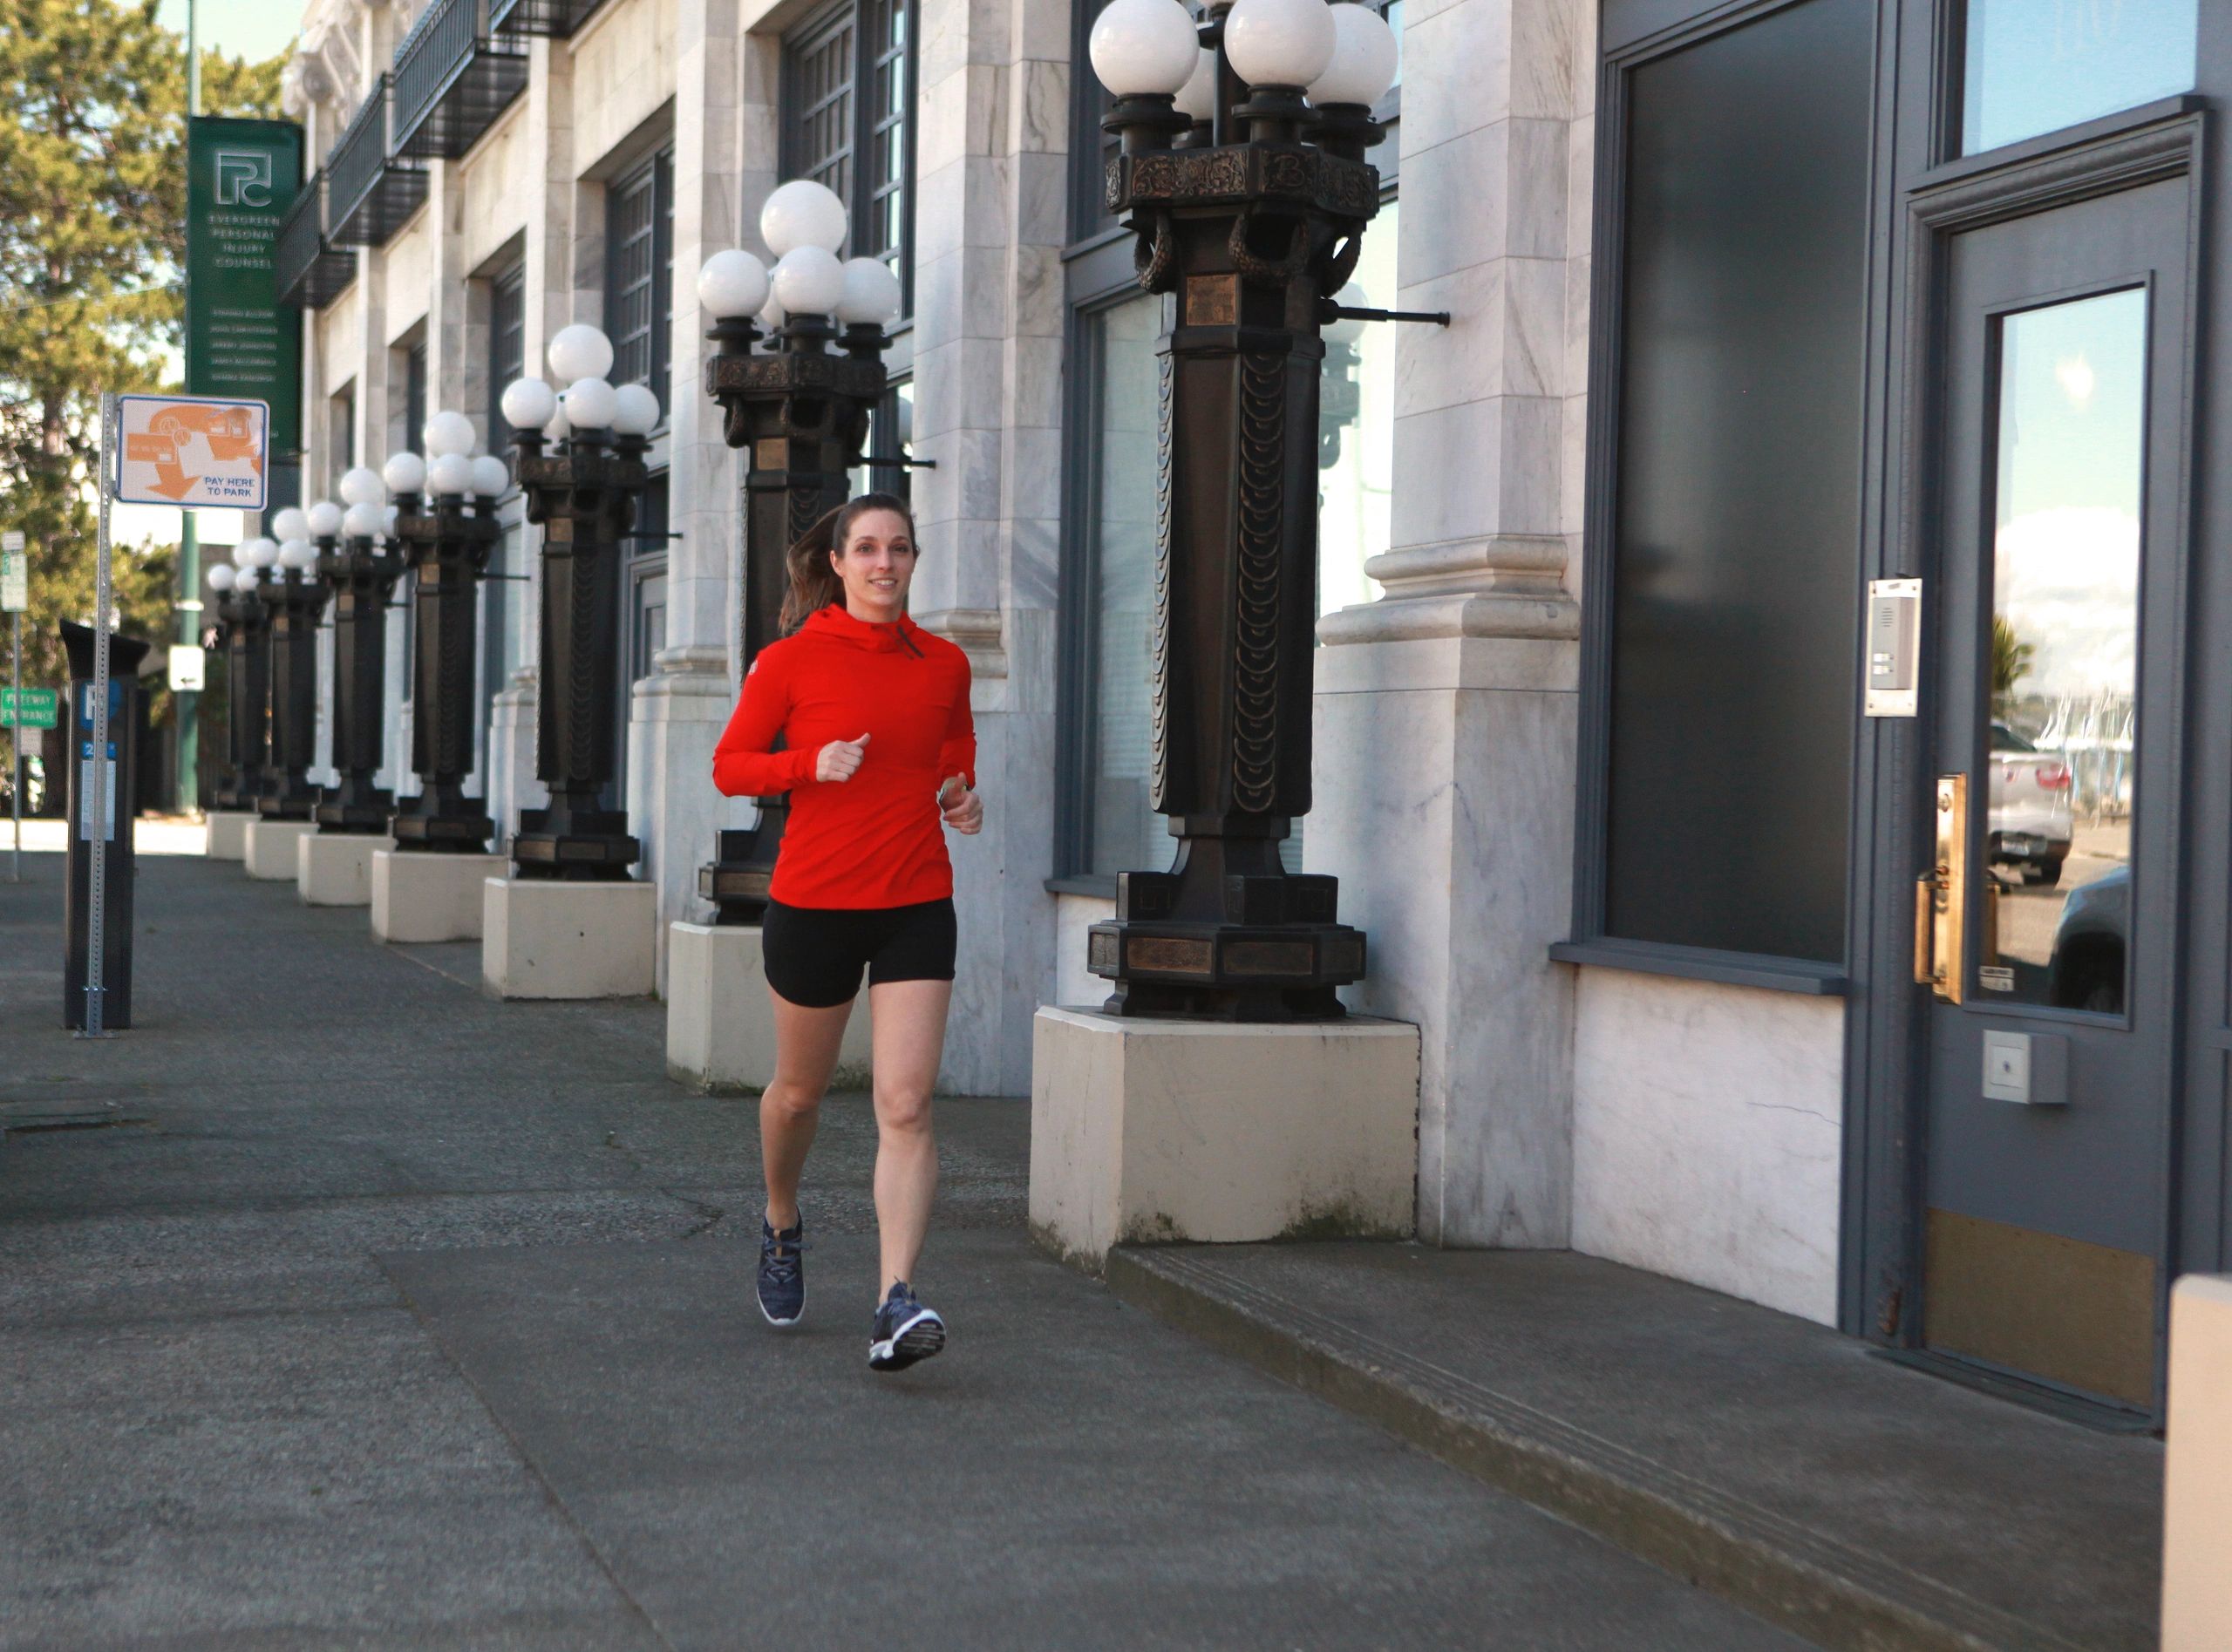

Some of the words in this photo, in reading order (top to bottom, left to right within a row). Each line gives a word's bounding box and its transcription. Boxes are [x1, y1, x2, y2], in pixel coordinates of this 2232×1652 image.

[208, 214, 280, 227] EVERGREEN
[212, 228, 275, 240] PERSONAL
[223, 243, 266, 254] INJURY
[215, 258, 271, 269] COUNSEL
[205, 477, 224, 486] PAY
[228, 478, 255, 487] HERE
[208, 487, 221, 496] TO
[224, 488, 251, 497] PARK
